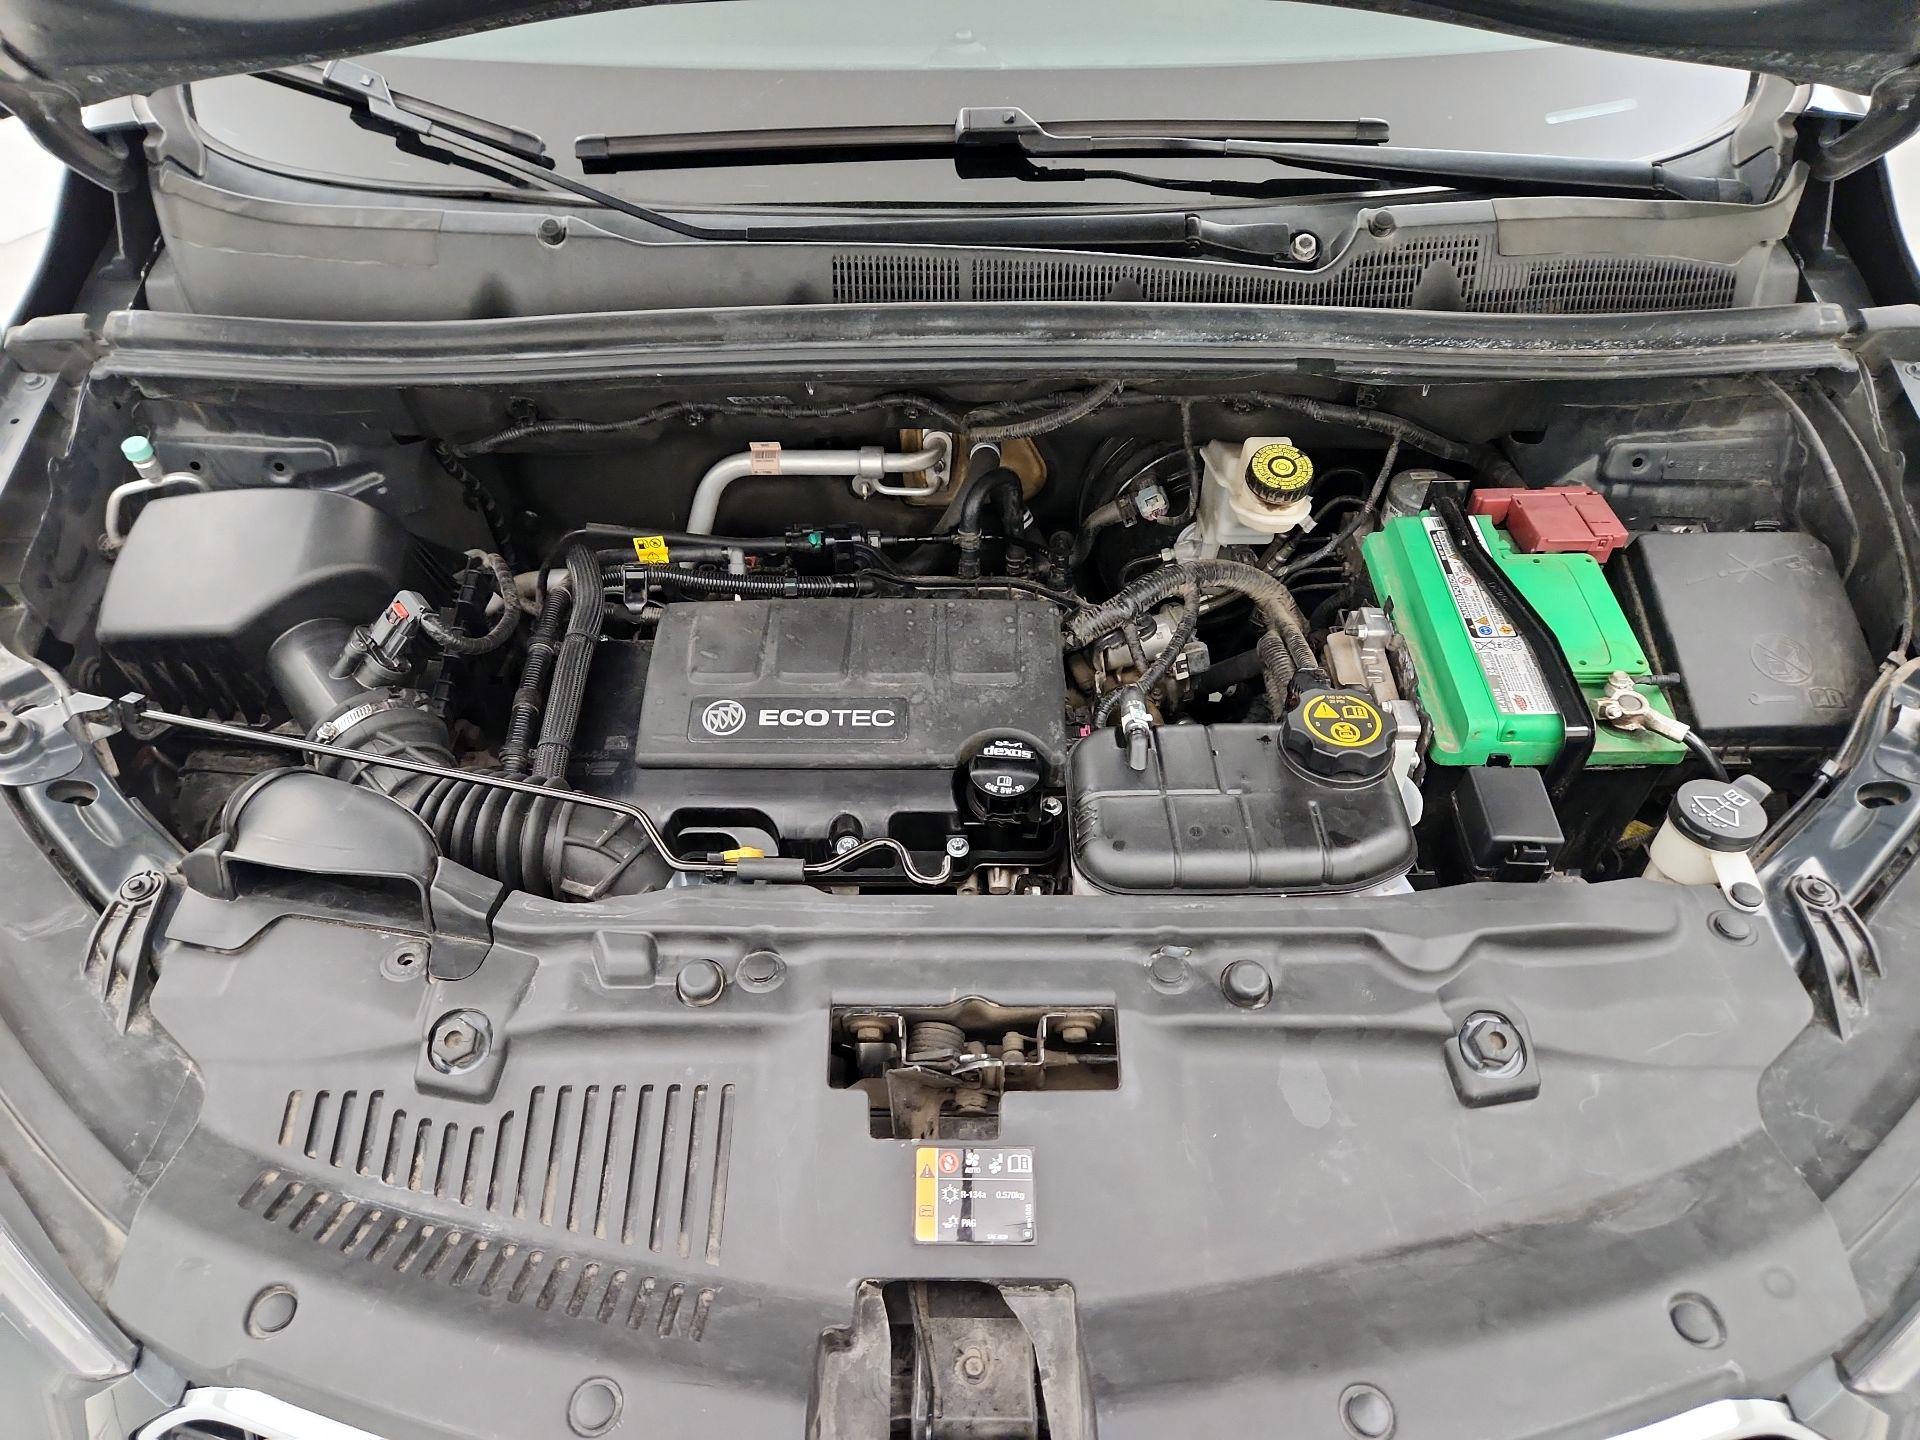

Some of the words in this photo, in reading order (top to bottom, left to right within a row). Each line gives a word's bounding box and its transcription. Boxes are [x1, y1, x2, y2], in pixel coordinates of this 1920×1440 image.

[758, 709, 896, 727] ECOTEC
[983, 745, 1034, 759] dexos
[984, 782, 999, 793] SAE
[1000, 784, 1025, 794] 5W-30
[960, 1190, 987, 1199] R-134a
[995, 1190, 1025, 1201] 0.570kg
[961, 1218, 977, 1228] PAG
